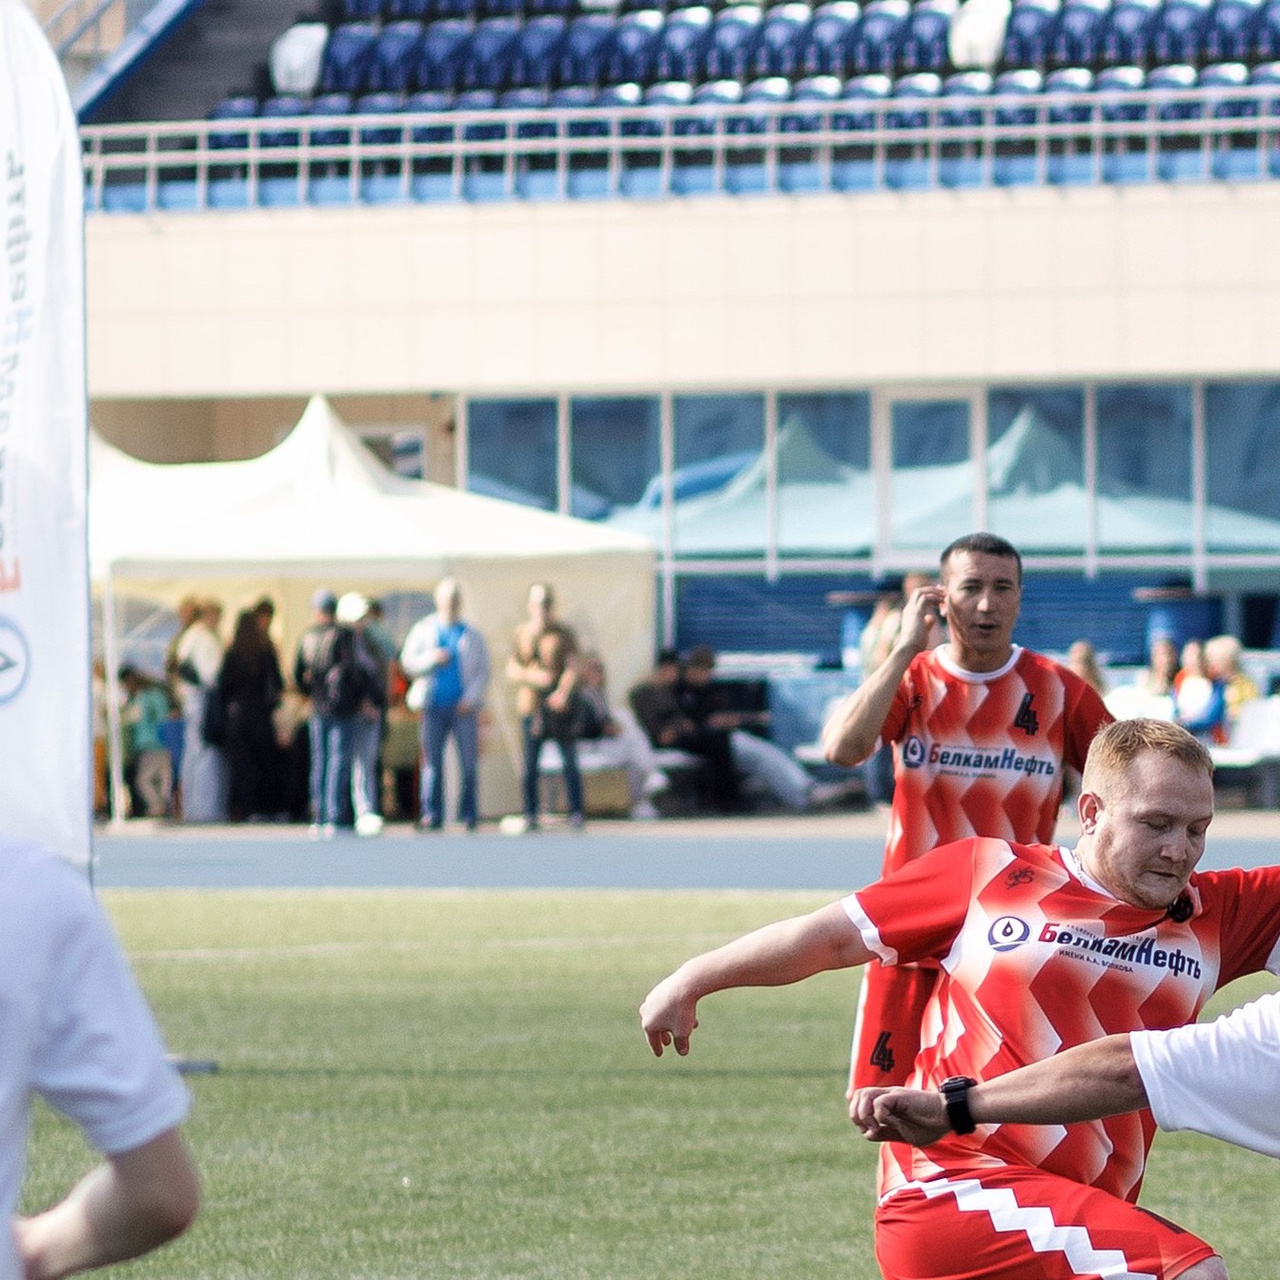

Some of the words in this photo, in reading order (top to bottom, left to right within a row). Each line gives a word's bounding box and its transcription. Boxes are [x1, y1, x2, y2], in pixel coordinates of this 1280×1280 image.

[1014, 693, 1039, 735] 4
[929, 743, 1055, 777] БелкамНефть
[1038, 922, 1201, 979] БелкамНефть
[870, 1031, 894, 1072] 4
